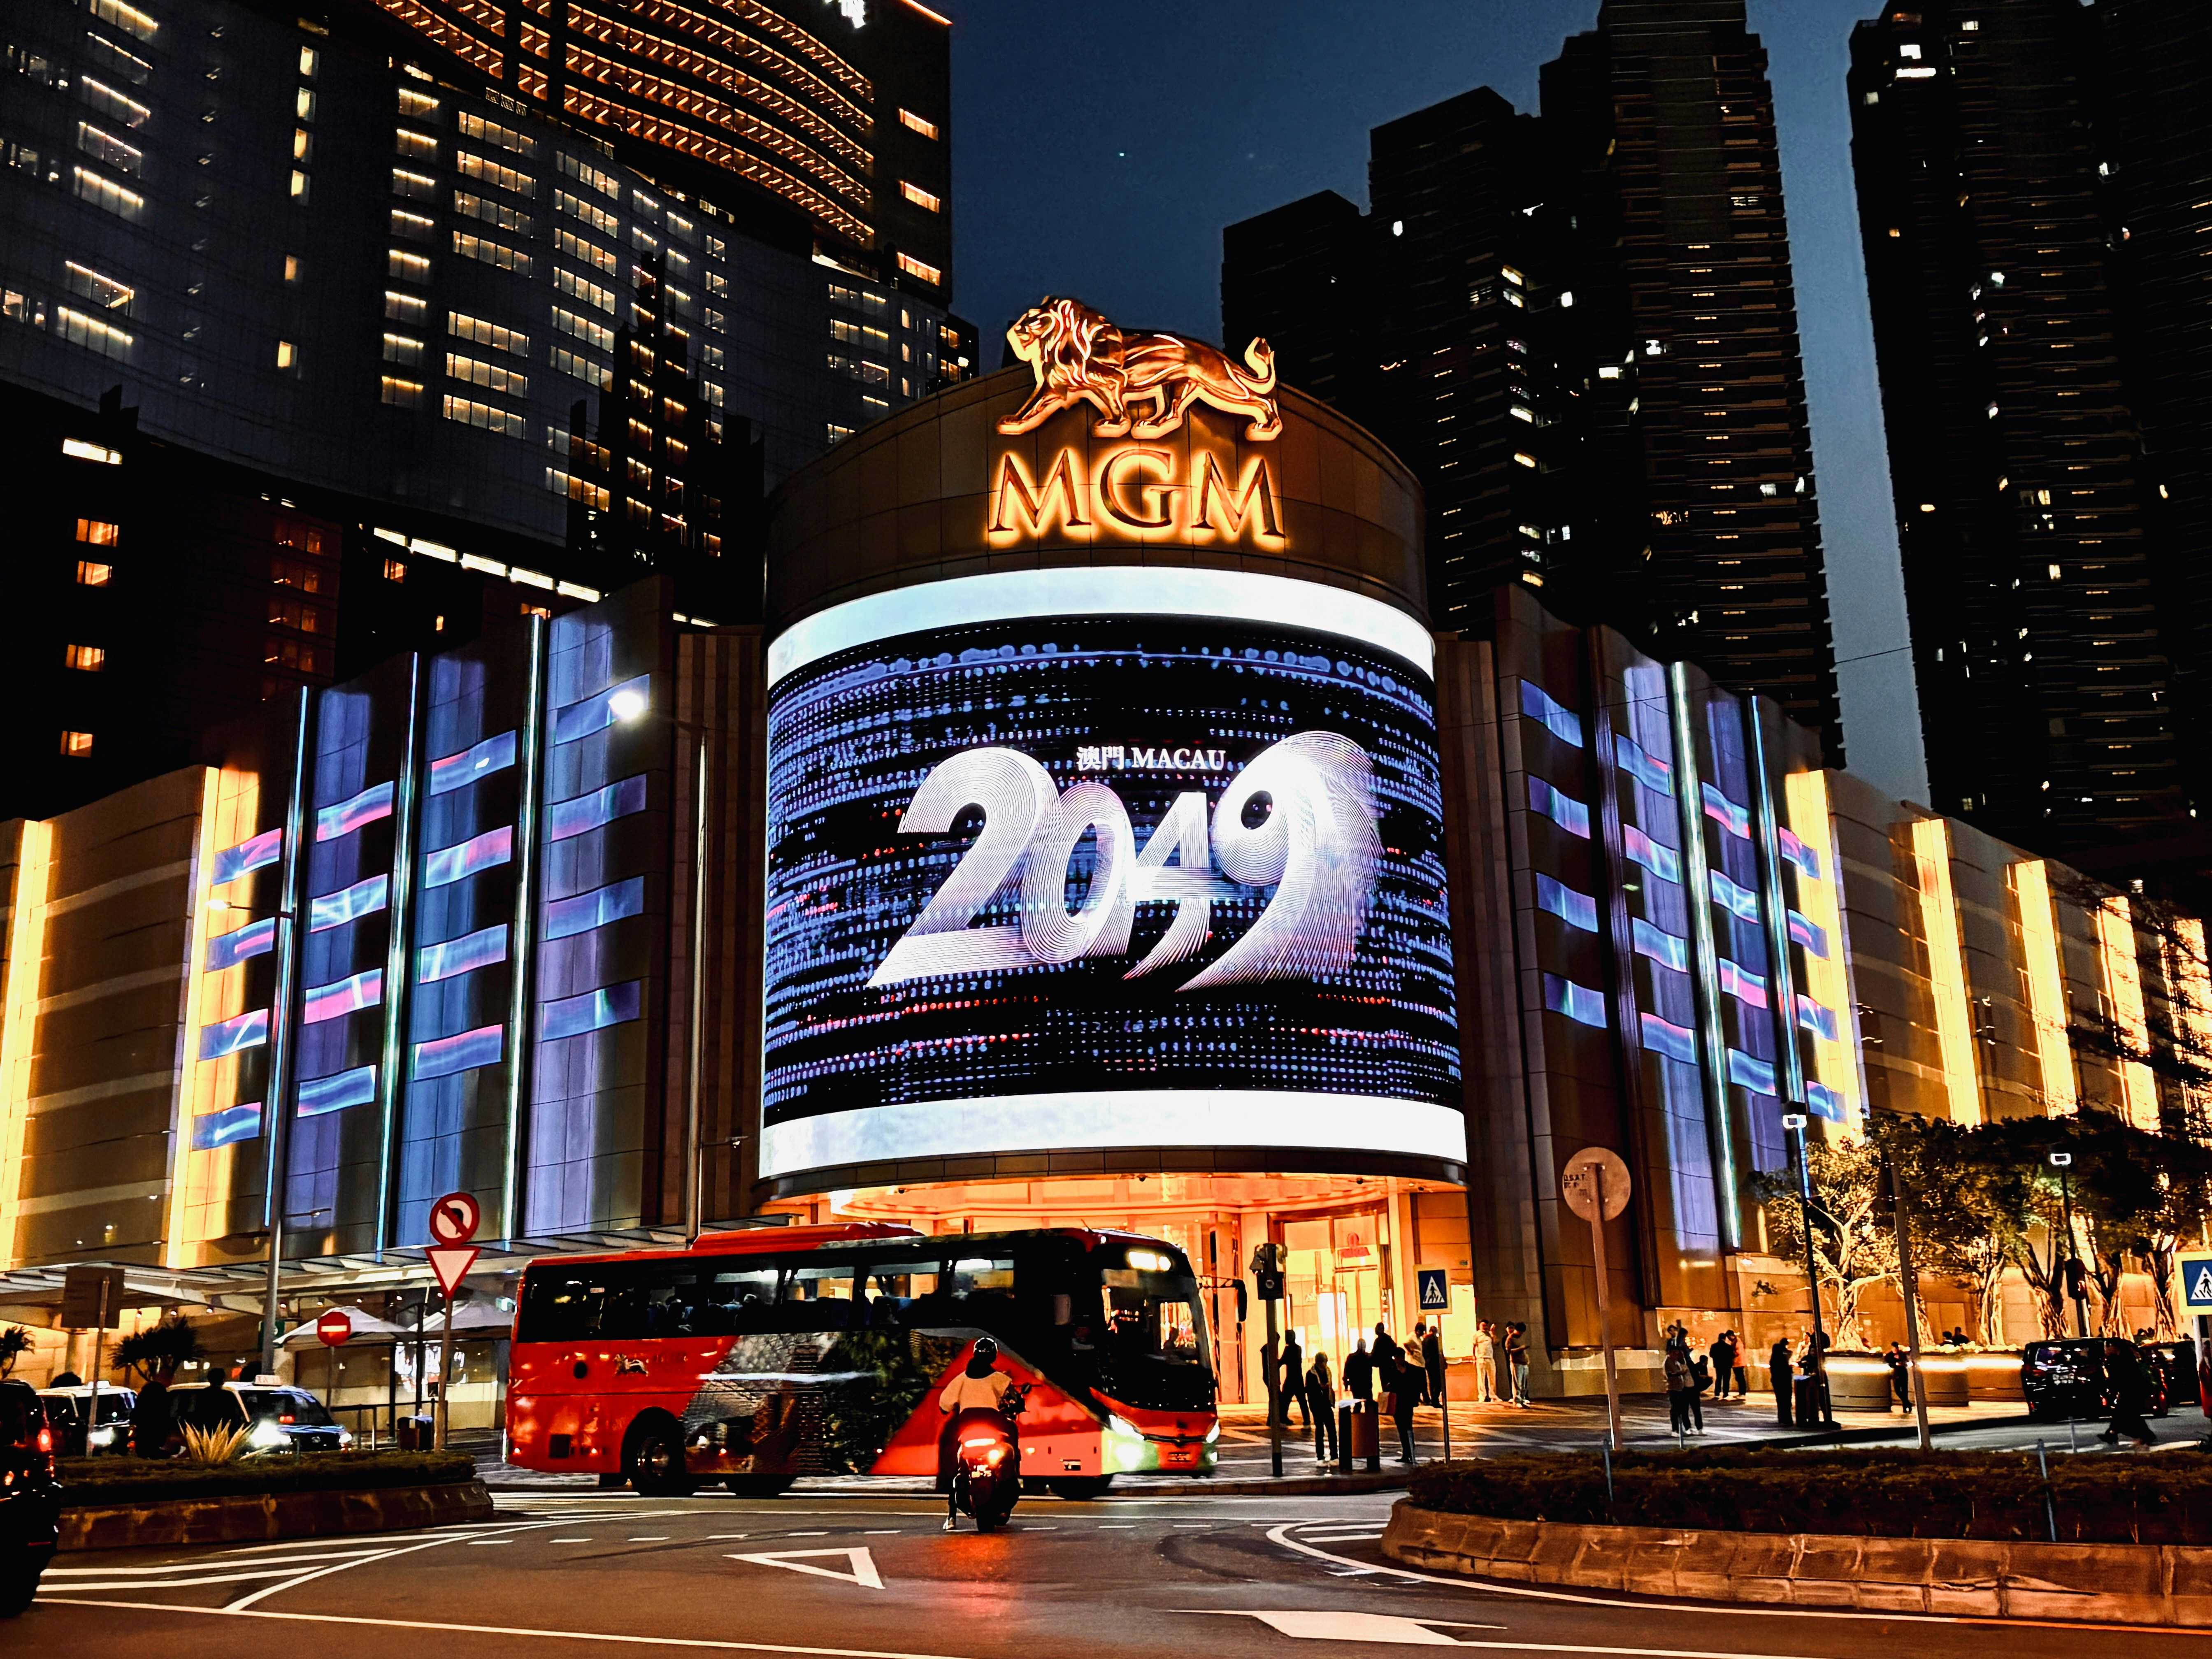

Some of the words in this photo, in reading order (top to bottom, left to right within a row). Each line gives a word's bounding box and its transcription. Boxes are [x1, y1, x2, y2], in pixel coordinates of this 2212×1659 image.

[989, 449, 1285, 538] MGM
[1076, 746, 1125, 771] 澳門
[1131, 747, 1226, 771] MACAU
[866, 731, 1384, 992] 2049
